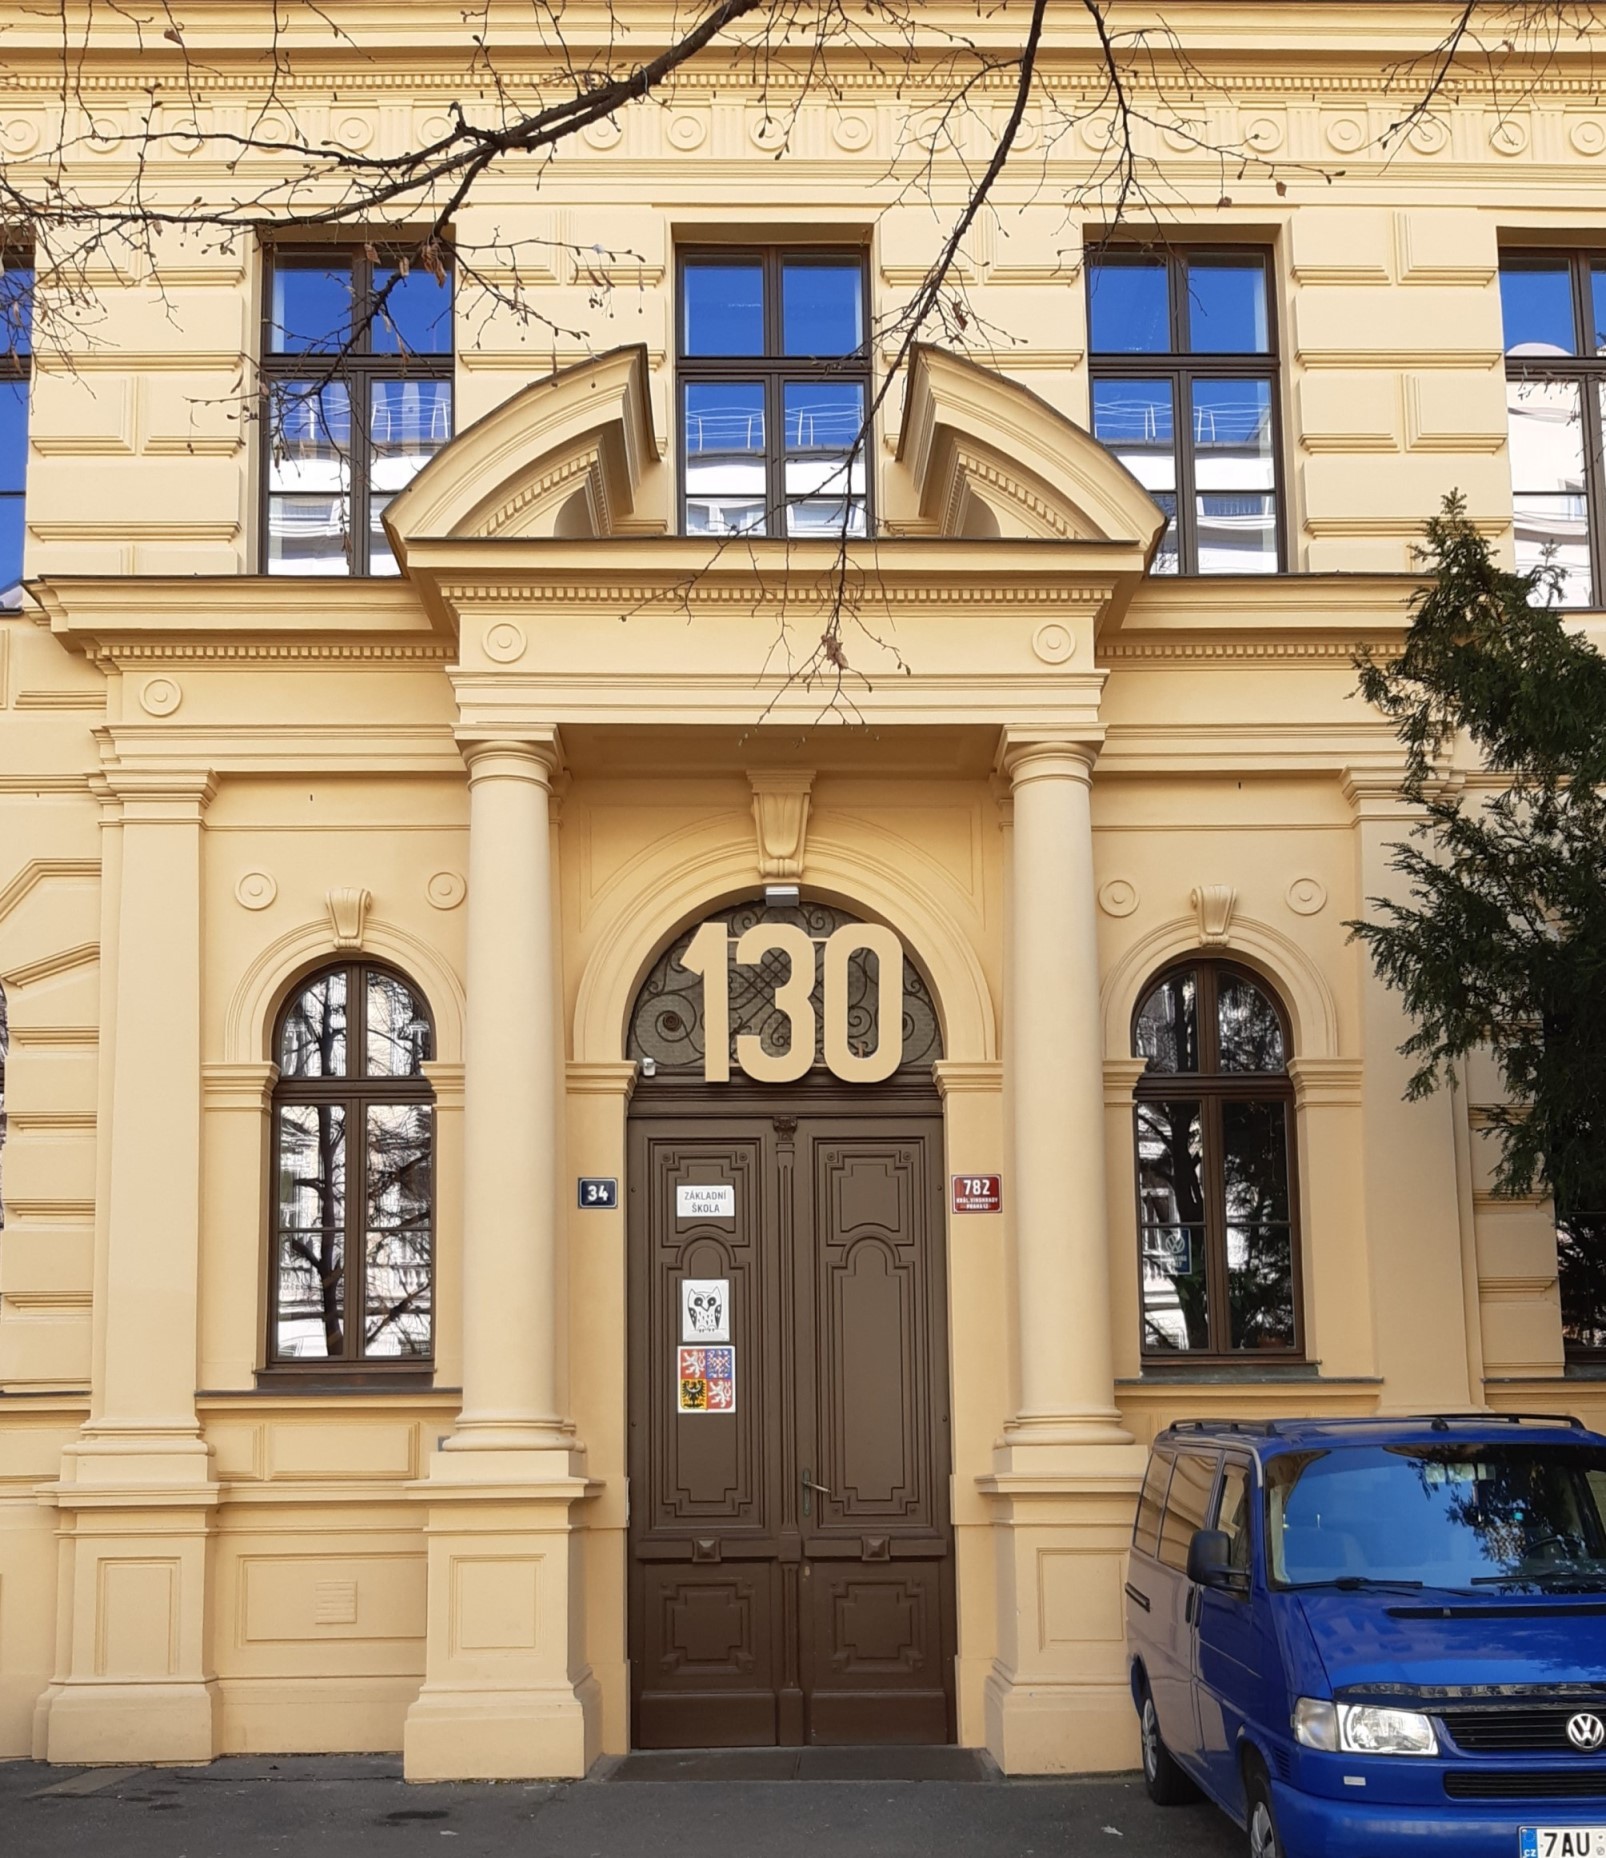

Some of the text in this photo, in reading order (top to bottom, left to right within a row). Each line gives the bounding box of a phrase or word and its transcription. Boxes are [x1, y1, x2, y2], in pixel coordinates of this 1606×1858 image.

[680, 922, 903, 1083] 130
[588, 1185, 609, 1201] 34
[684, 1189, 727, 1201] ZÁKLADNÍ
[963, 1179, 990, 1195] 782
[691, 1202, 720, 1213] ŠKOLA
[1544, 1832, 1590, 1857] 7AU
[1523, 1849, 1536, 1857] CZ
